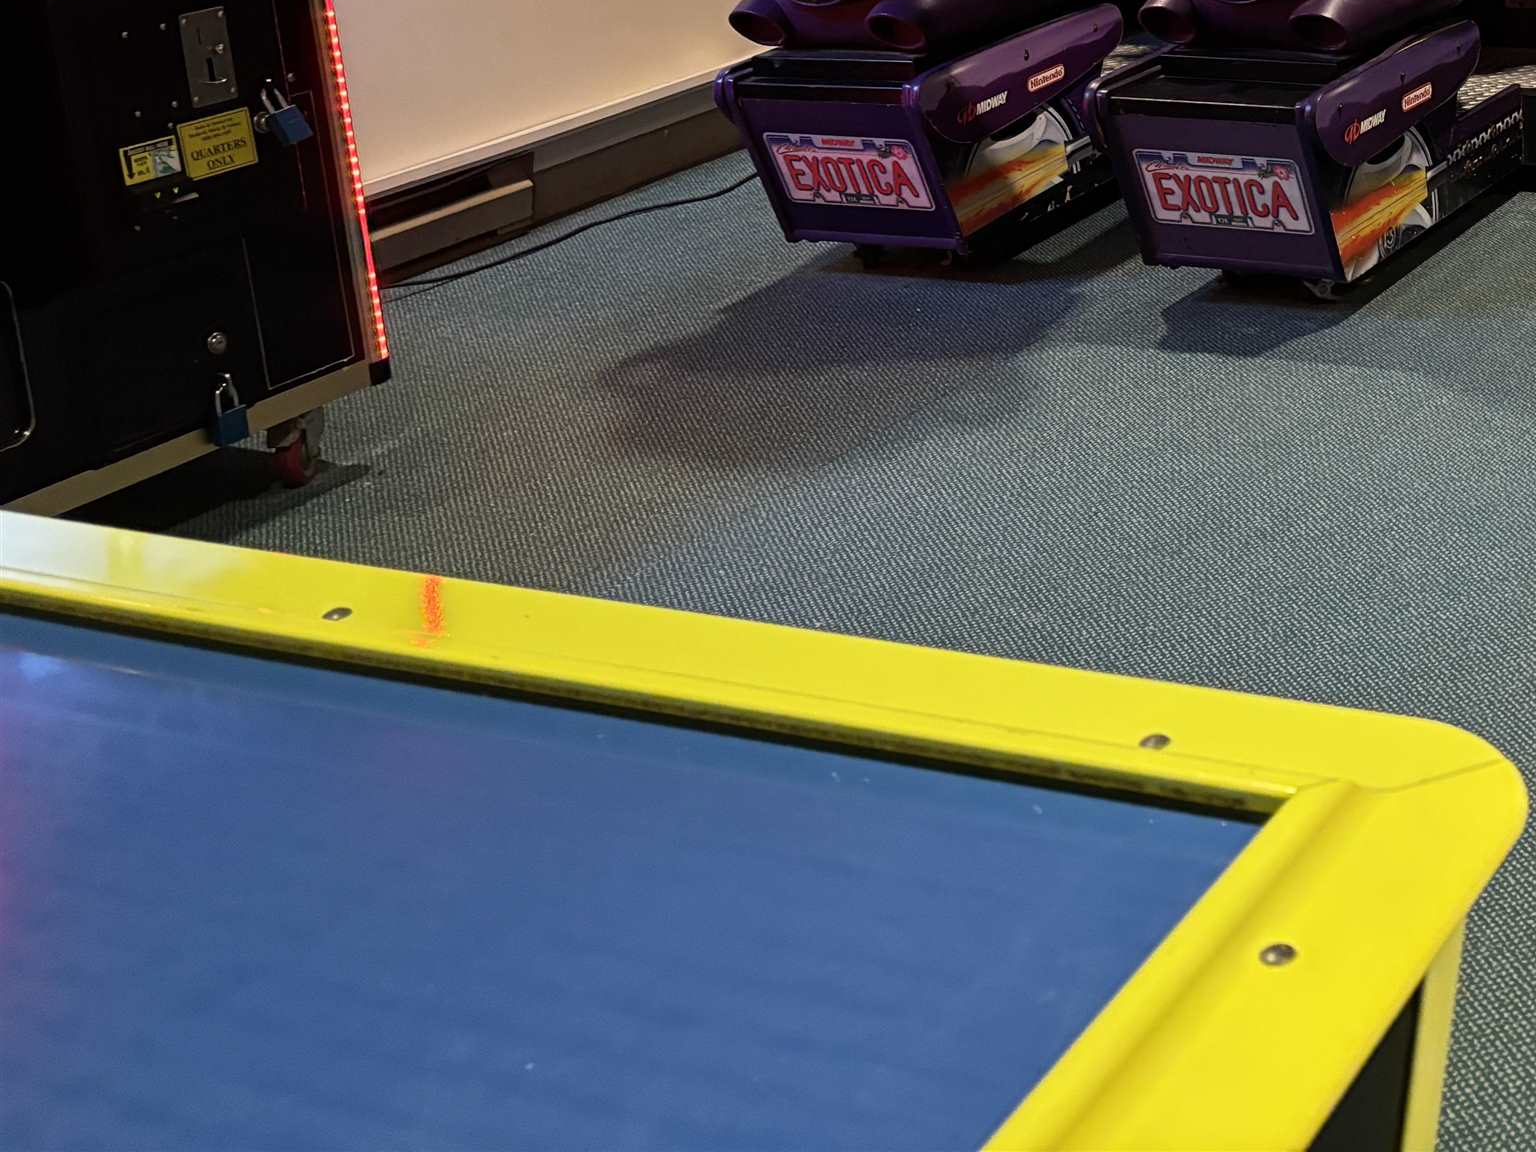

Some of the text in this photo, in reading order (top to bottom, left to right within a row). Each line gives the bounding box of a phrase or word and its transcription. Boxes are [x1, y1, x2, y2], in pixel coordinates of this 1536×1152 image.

[1030, 68, 1063, 89] Nintendo
[976, 91, 1008, 115] MIDWAY
[1360, 109, 1387, 134] MIDWAY
[191, 137, 247, 161] QUARTERS
[207, 155, 236, 170] ONLY
[784, 155, 919, 198] EXOTICA
[1152, 172, 1299, 221] EXOTICA
